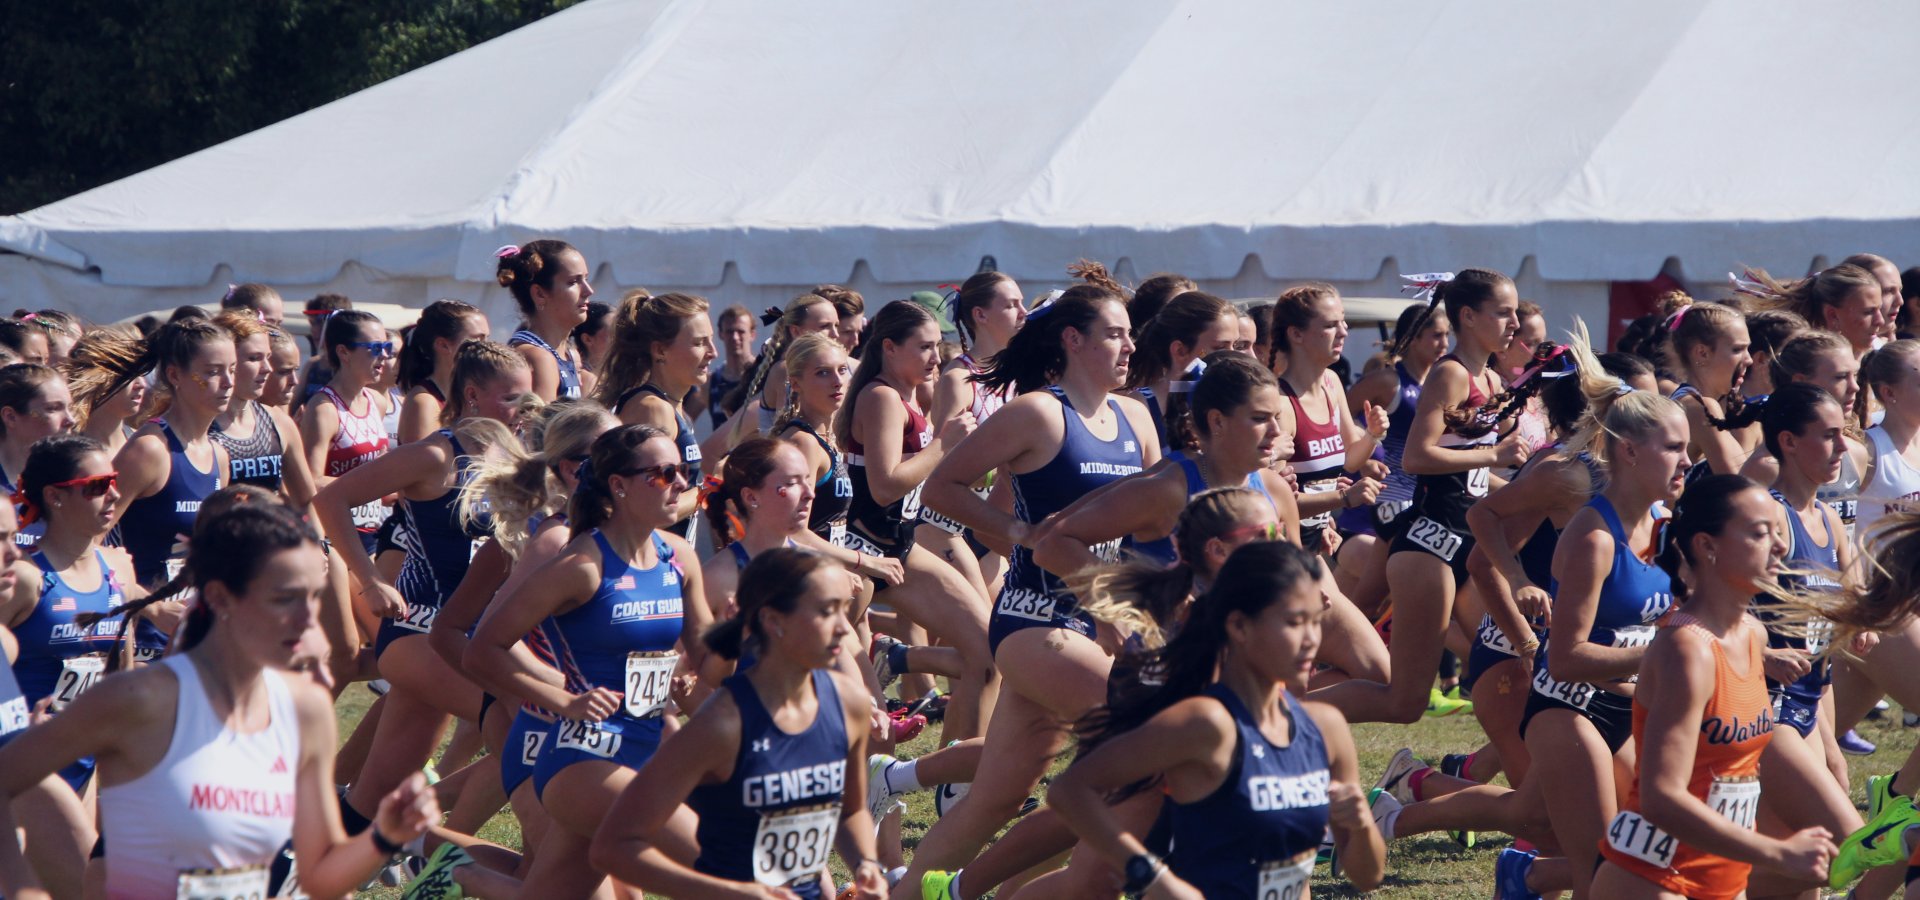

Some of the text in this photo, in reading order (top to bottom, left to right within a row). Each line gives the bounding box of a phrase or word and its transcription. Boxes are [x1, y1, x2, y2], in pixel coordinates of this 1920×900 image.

[1411, 518, 1457, 556] 2231
[611, 601, 656, 619] COAST
[1002, 586, 1053, 618] 3232
[51, 622, 95, 639] COA
[1537, 669, 1591, 707] 4148
[559, 719, 617, 755] 2451
[189, 784, 296, 818] MONTCLAI
[743, 760, 846, 807] GENESE
[760, 824, 831, 873] 3831
[1610, 812, 1674, 862] 4114
